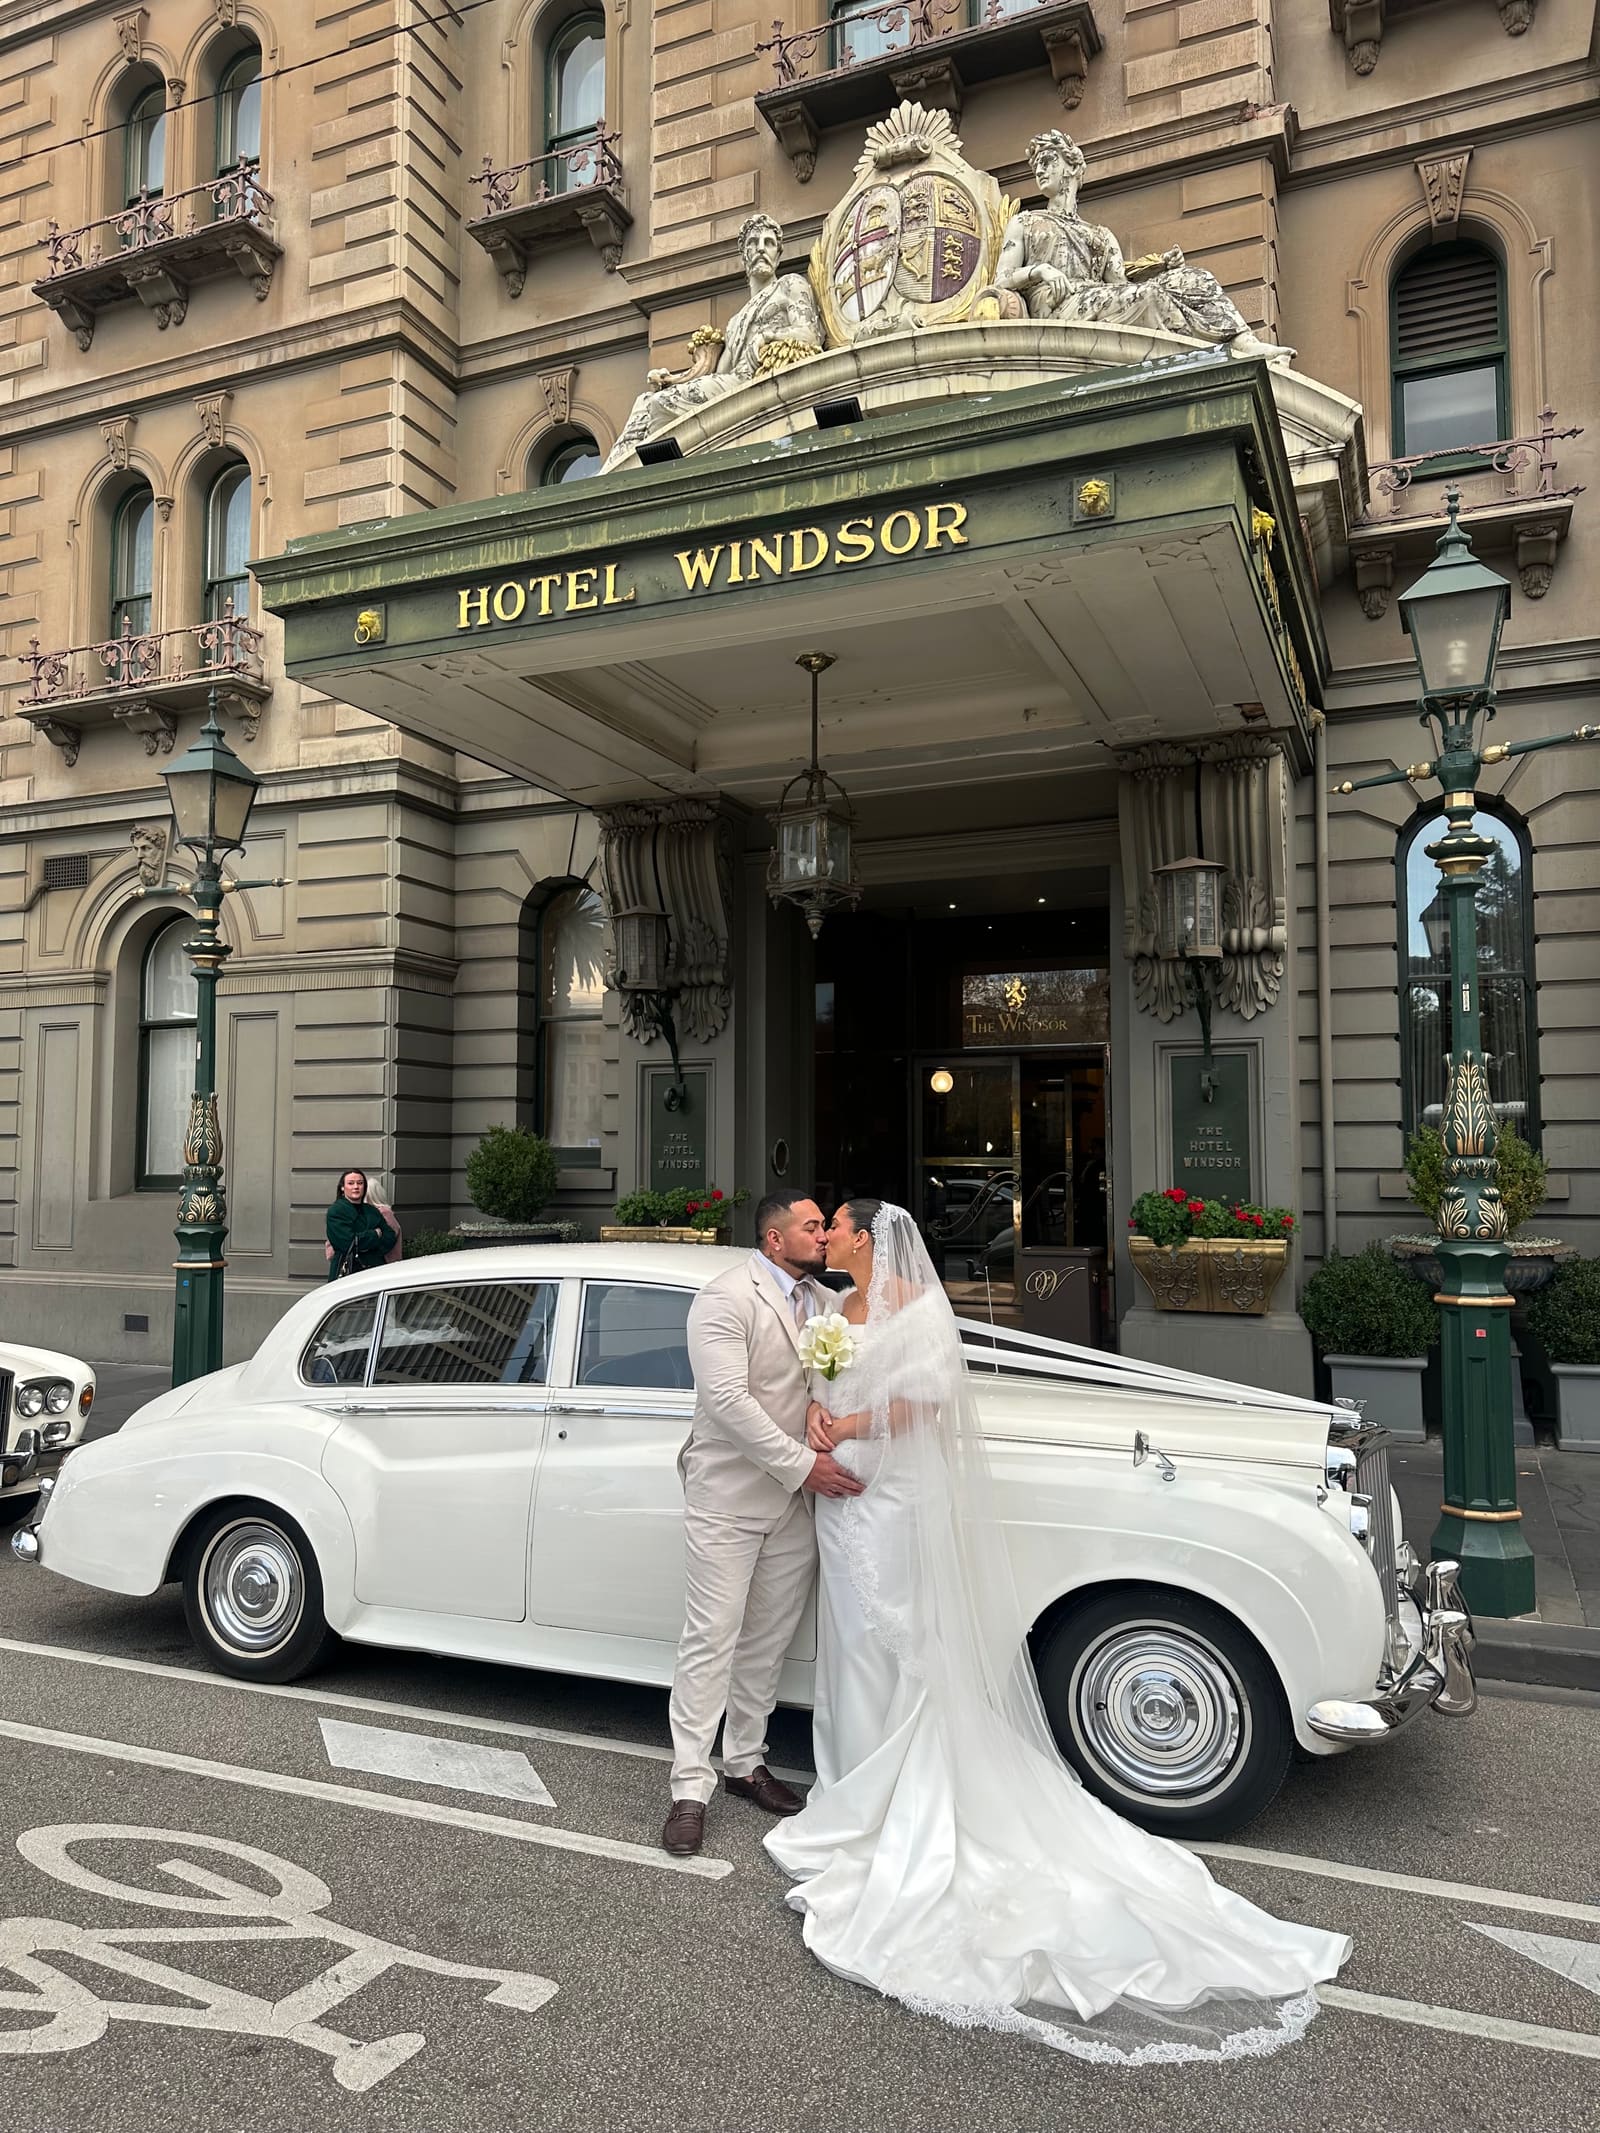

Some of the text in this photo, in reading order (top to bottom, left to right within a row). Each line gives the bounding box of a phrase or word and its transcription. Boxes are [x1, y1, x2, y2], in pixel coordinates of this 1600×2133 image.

[456, 502, 970, 630] HOTEL WINDSOR
[1197, 1127, 1223, 1136] THE
[669, 1133, 688, 1142] THE
[663, 1145, 695, 1155] HOTEL
[1190, 1141, 1233, 1152] HOTEL
[658, 1160, 701, 1169] WINDSOR
[1183, 1157, 1241, 1168] WINDSOR
